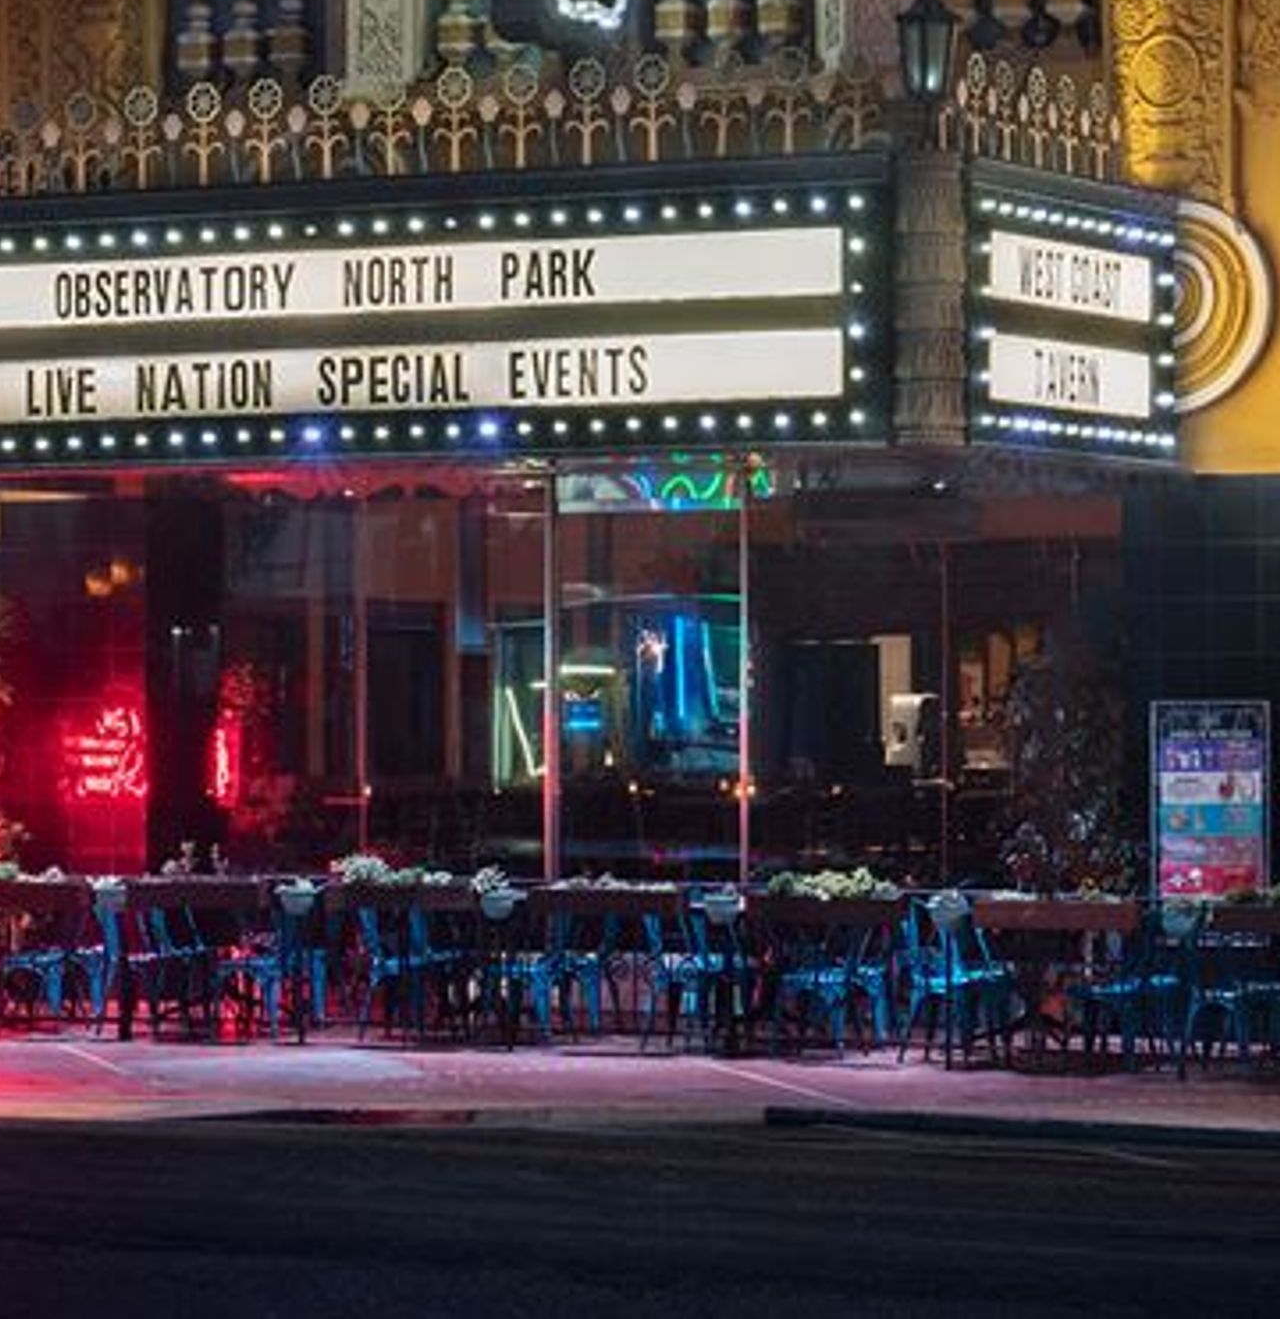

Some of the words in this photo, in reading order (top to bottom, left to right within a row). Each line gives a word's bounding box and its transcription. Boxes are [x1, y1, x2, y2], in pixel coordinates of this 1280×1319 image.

[54, 262, 295, 319] OBSERVATORY
[343, 255, 454, 307] NORTH
[500, 248, 596, 300] PARK
[25, 368, 98, 417] LIVE
[136, 359, 272, 413] NATION
[317, 352, 469, 407] SPECIAL
[508, 344, 648, 400] EVENTS
